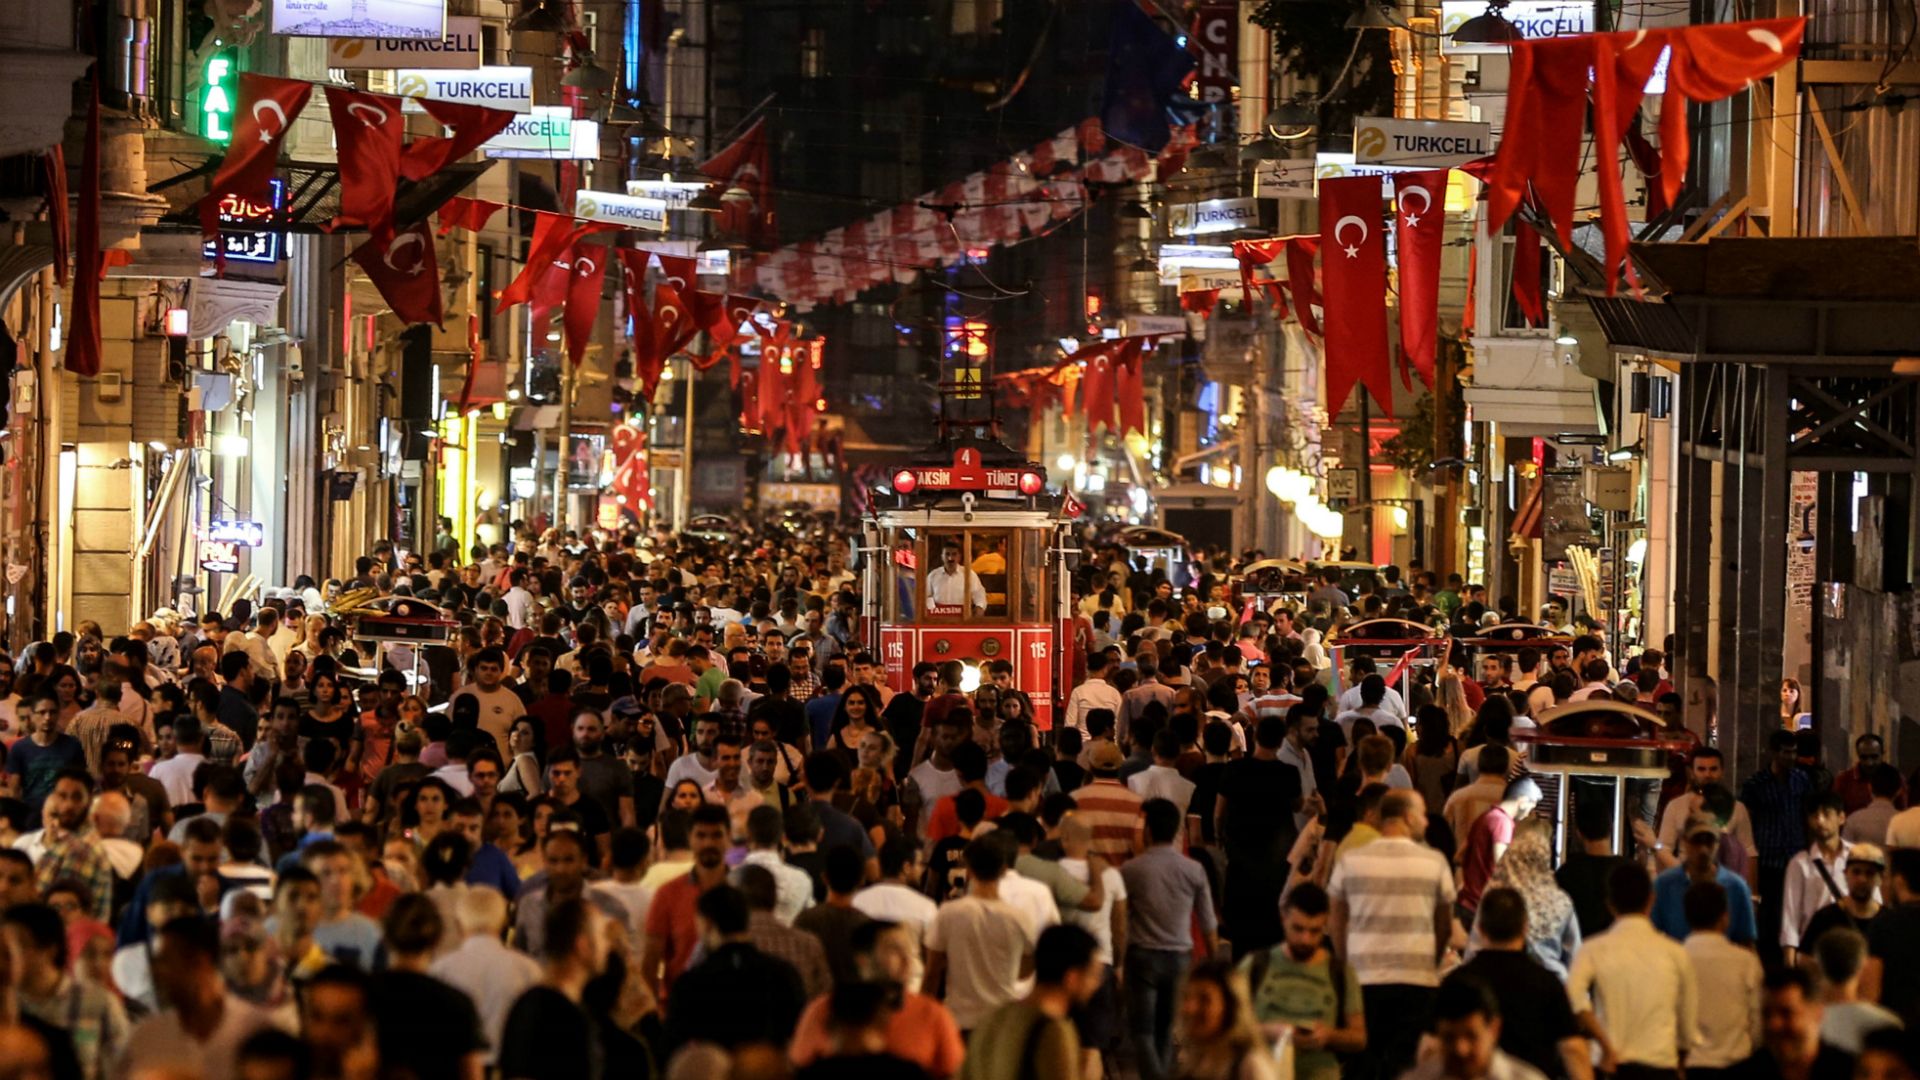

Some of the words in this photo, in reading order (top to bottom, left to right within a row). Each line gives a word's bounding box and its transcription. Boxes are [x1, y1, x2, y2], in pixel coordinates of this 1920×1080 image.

[435, 81, 531, 100] TURKCELL
[204, 59, 230, 140] FAL
[499, 121, 570, 137] RKCELL
[1393, 135, 1486, 155] TURKCELL
[601, 203, 663, 222] TURKCELL
[1197, 207, 1256, 224] TURKCELL
[961, 449, 970, 465] 4
[916, 468, 950, 486] AKSİM
[1331, 479, 1353, 489] WC
[888, 642, 904, 658] 115
[1030, 642, 1047, 658] 115
